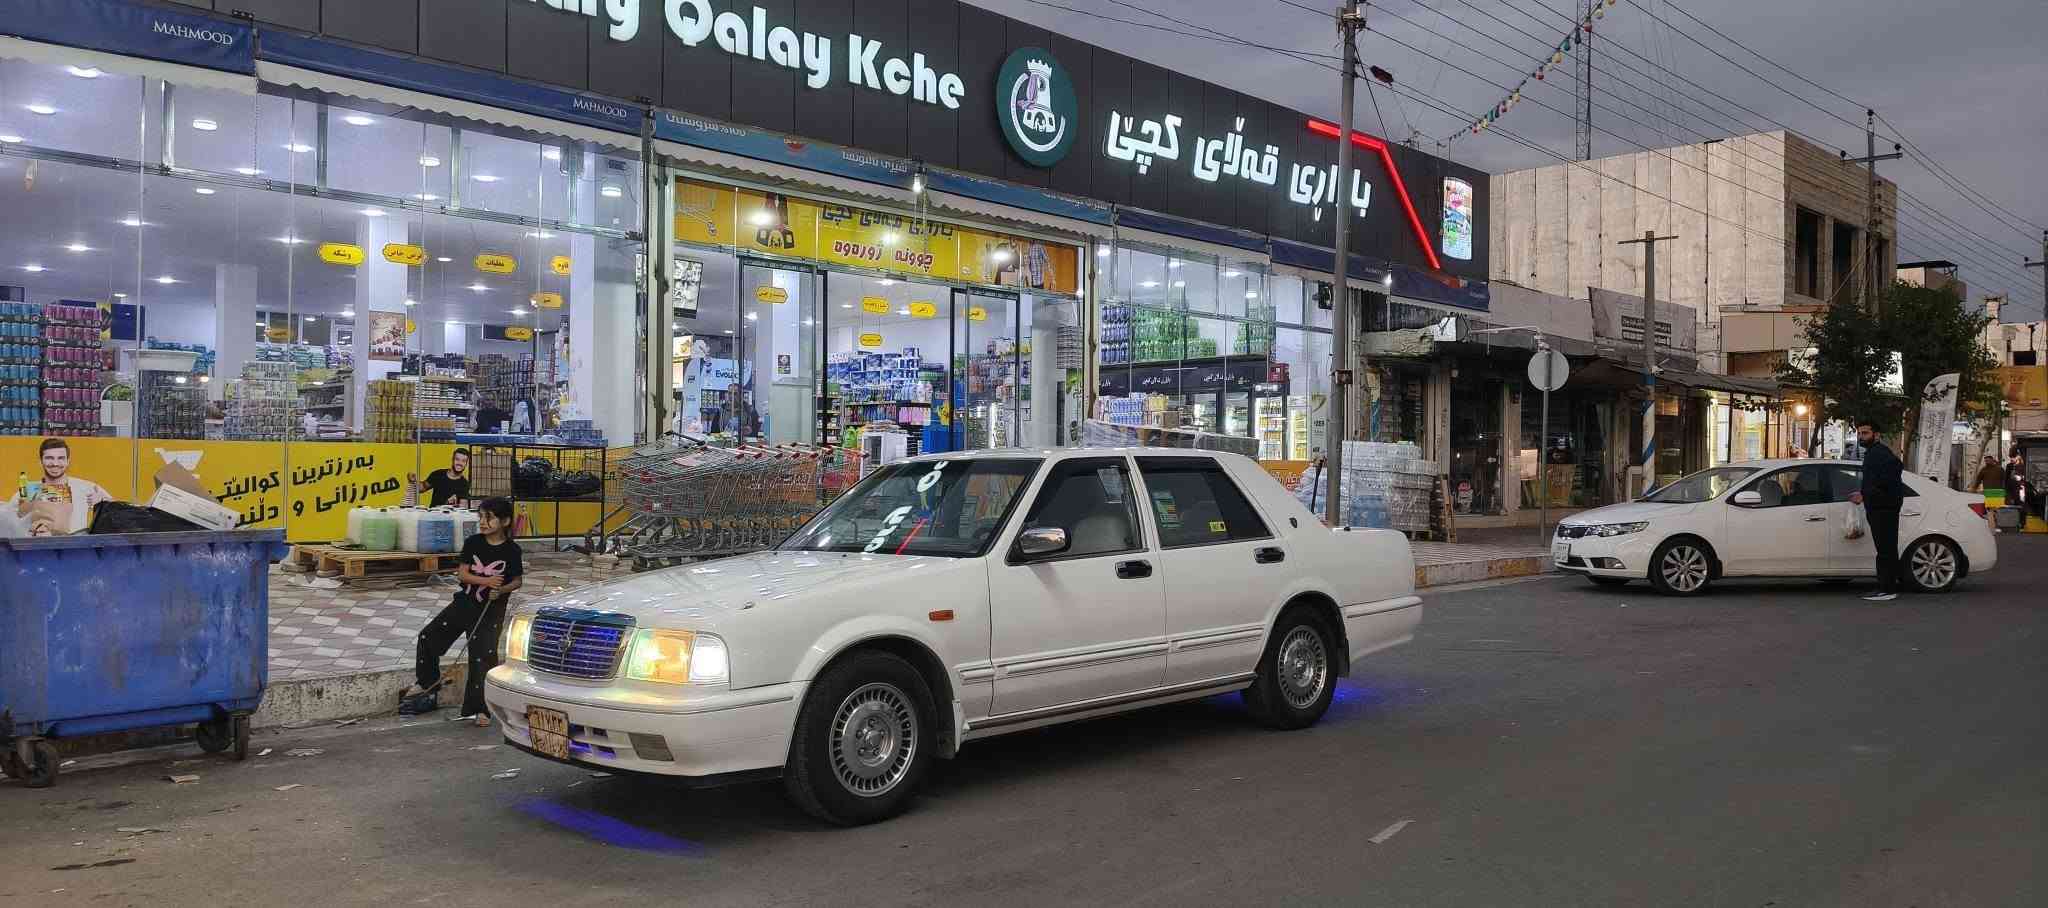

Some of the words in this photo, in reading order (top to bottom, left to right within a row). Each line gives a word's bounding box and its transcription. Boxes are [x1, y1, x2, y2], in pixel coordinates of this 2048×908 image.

[152, 19, 233, 45] MAHMOOD
[664, 0, 831, 89] Qalay
[848, 33, 965, 110] Kche
[573, 97, 627, 119] MAHMOOD
[1289, 163, 1372, 222] بااڕی
[292, 454, 374, 486] بەرزترین
[293, 500, 305, 516] و
[315, 476, 400, 513] هەرزانی
